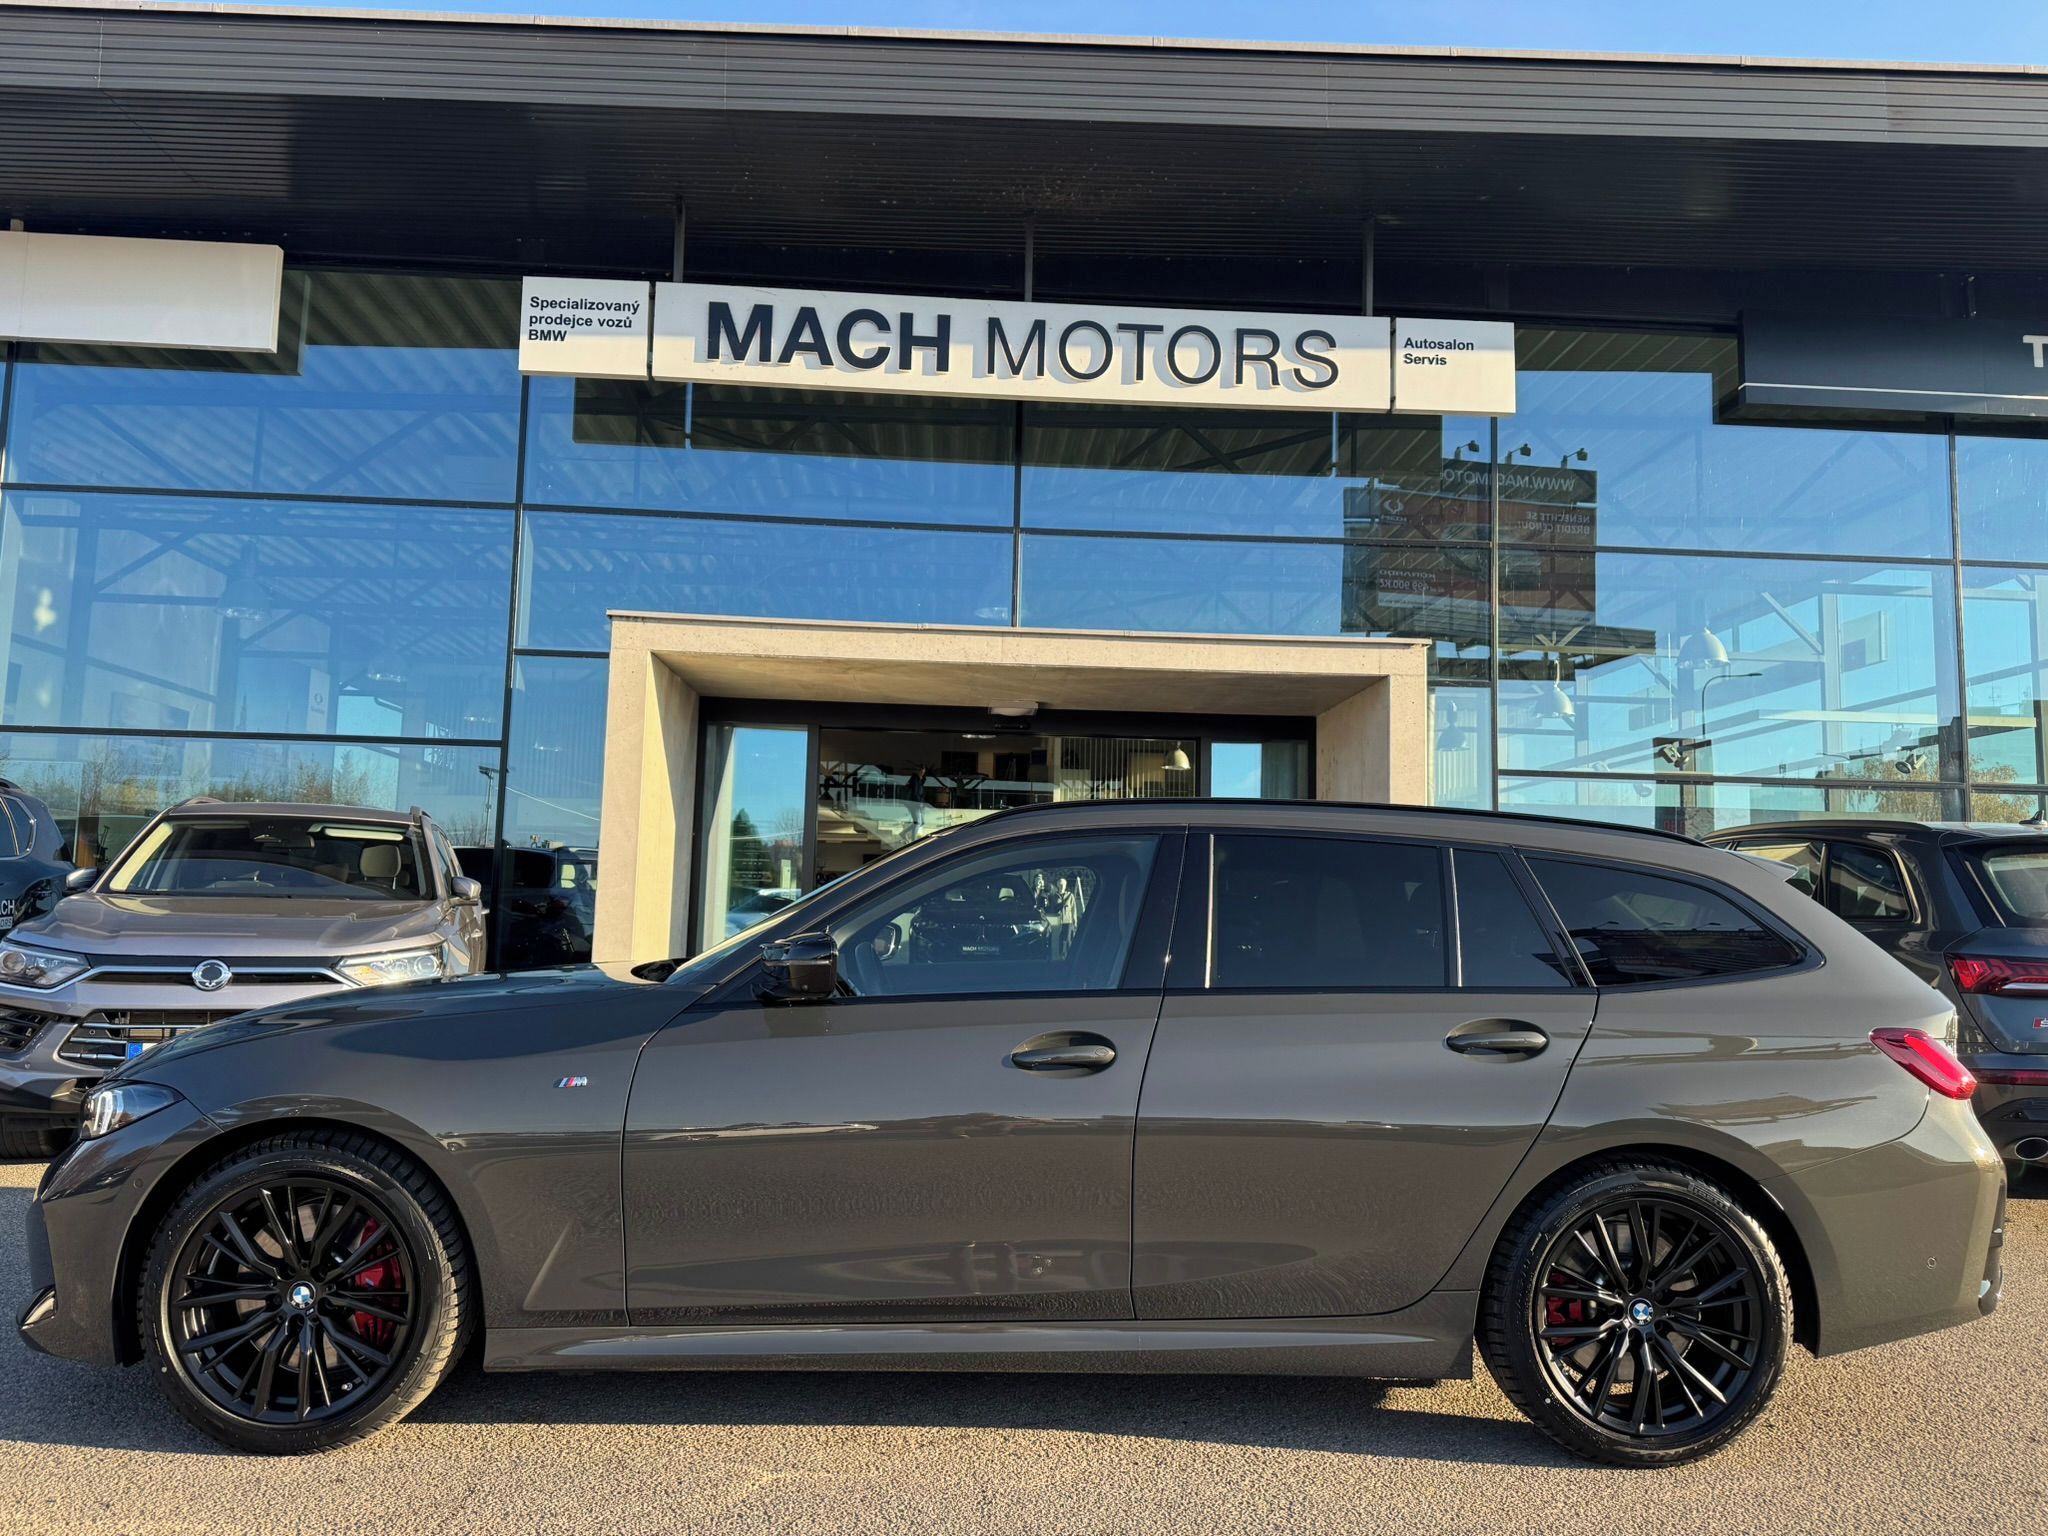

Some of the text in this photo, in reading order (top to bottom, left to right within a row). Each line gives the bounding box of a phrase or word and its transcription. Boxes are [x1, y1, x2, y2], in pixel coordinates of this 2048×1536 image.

[529, 296, 640, 315] Specializovaný
[529, 313, 632, 329] prodejce vozů
[528, 329, 567, 342] BMW
[707, 301, 1339, 389] MACH MOTORS
[1403, 337, 1474, 351] Autosalon
[1403, 353, 1447, 366] Servis
[0, 899, 15, 915] CH
